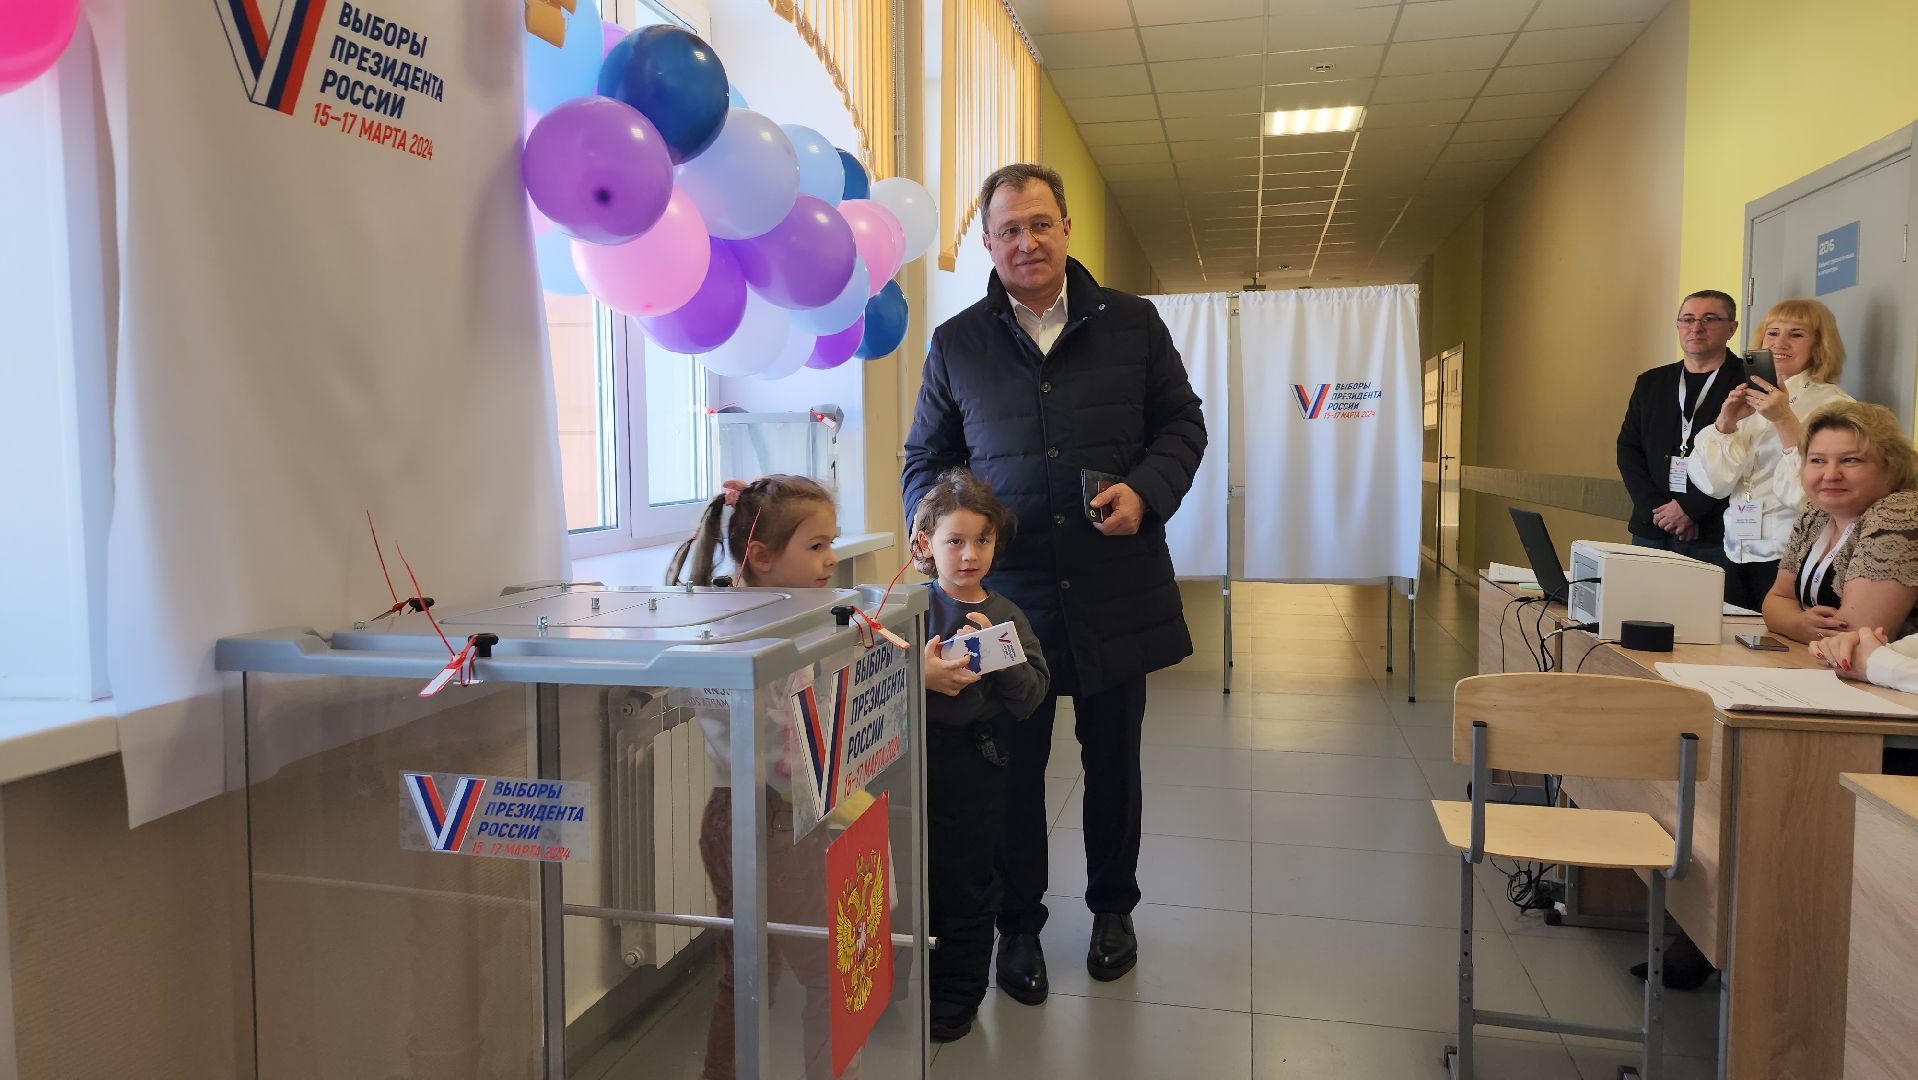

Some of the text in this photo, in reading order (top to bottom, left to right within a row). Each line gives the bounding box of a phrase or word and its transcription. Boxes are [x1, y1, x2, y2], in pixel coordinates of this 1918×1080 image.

[338, 1, 428, 58] ВЫБОРЫ
[330, 35, 444, 102] ПРЕЗИДЕНТА
[320, 68, 405, 119] РОССИИ
[359, 117, 407, 152] МАРТА
[409, 133, 434, 160] 2024
[1331, 391, 1382, 400] ПРЕЗИДЕНТА
[1335, 382, 1371, 391] ВЫБОРЫ
[1327, 402, 1360, 410] РОССИИ
[855, 643, 893, 686] ВЫБОРЫ
[851, 667, 905, 725] ПРЕЗИДЕНТА
[847, 714, 884, 764] РОССИИ
[864, 746, 885, 778] МАРТА
[493, 782, 563, 799] ВЫБОРЫ
[485, 802, 585, 822] ПРЕЗИДЕНТА
[478, 821, 541, 839] РОССИИ
[471, 841, 571, 860] 1517 МАРТА 2024
